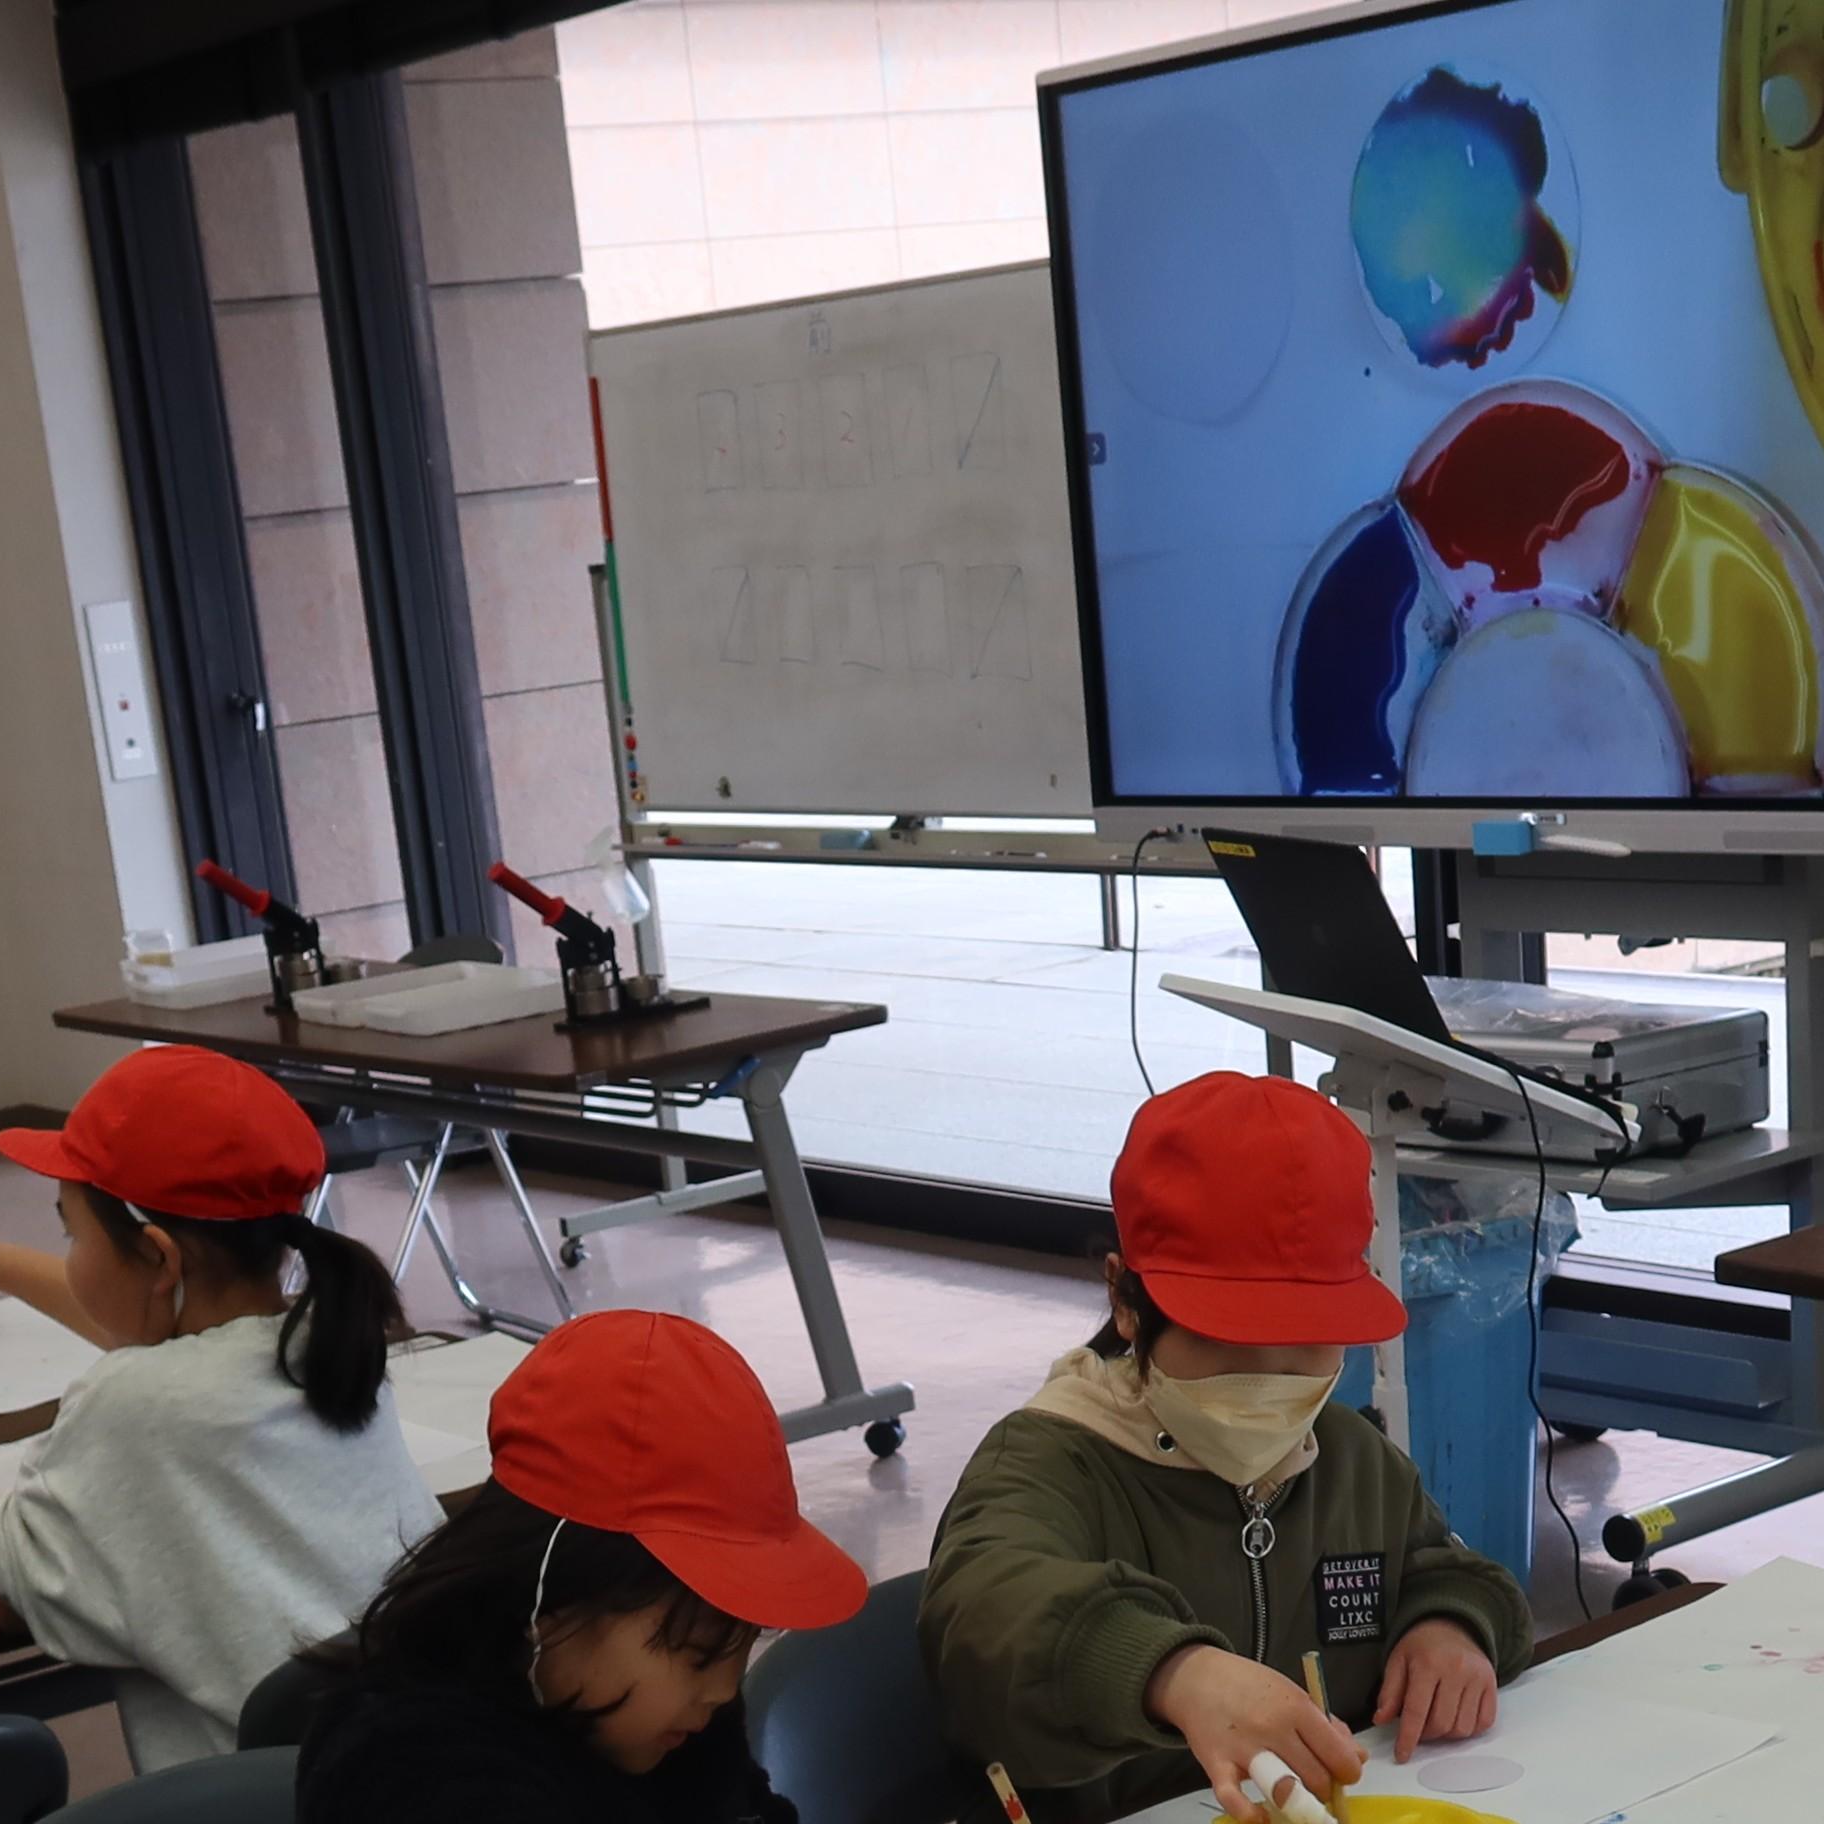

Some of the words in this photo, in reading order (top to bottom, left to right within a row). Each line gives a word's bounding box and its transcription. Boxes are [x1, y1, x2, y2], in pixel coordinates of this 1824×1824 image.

[1323, 1575, 1364, 1591] MAKE
[1370, 1573, 1380, 1587] IT
[1328, 1592, 1379, 1608] COUNT
[1339, 1611, 1373, 1626] LTXC
